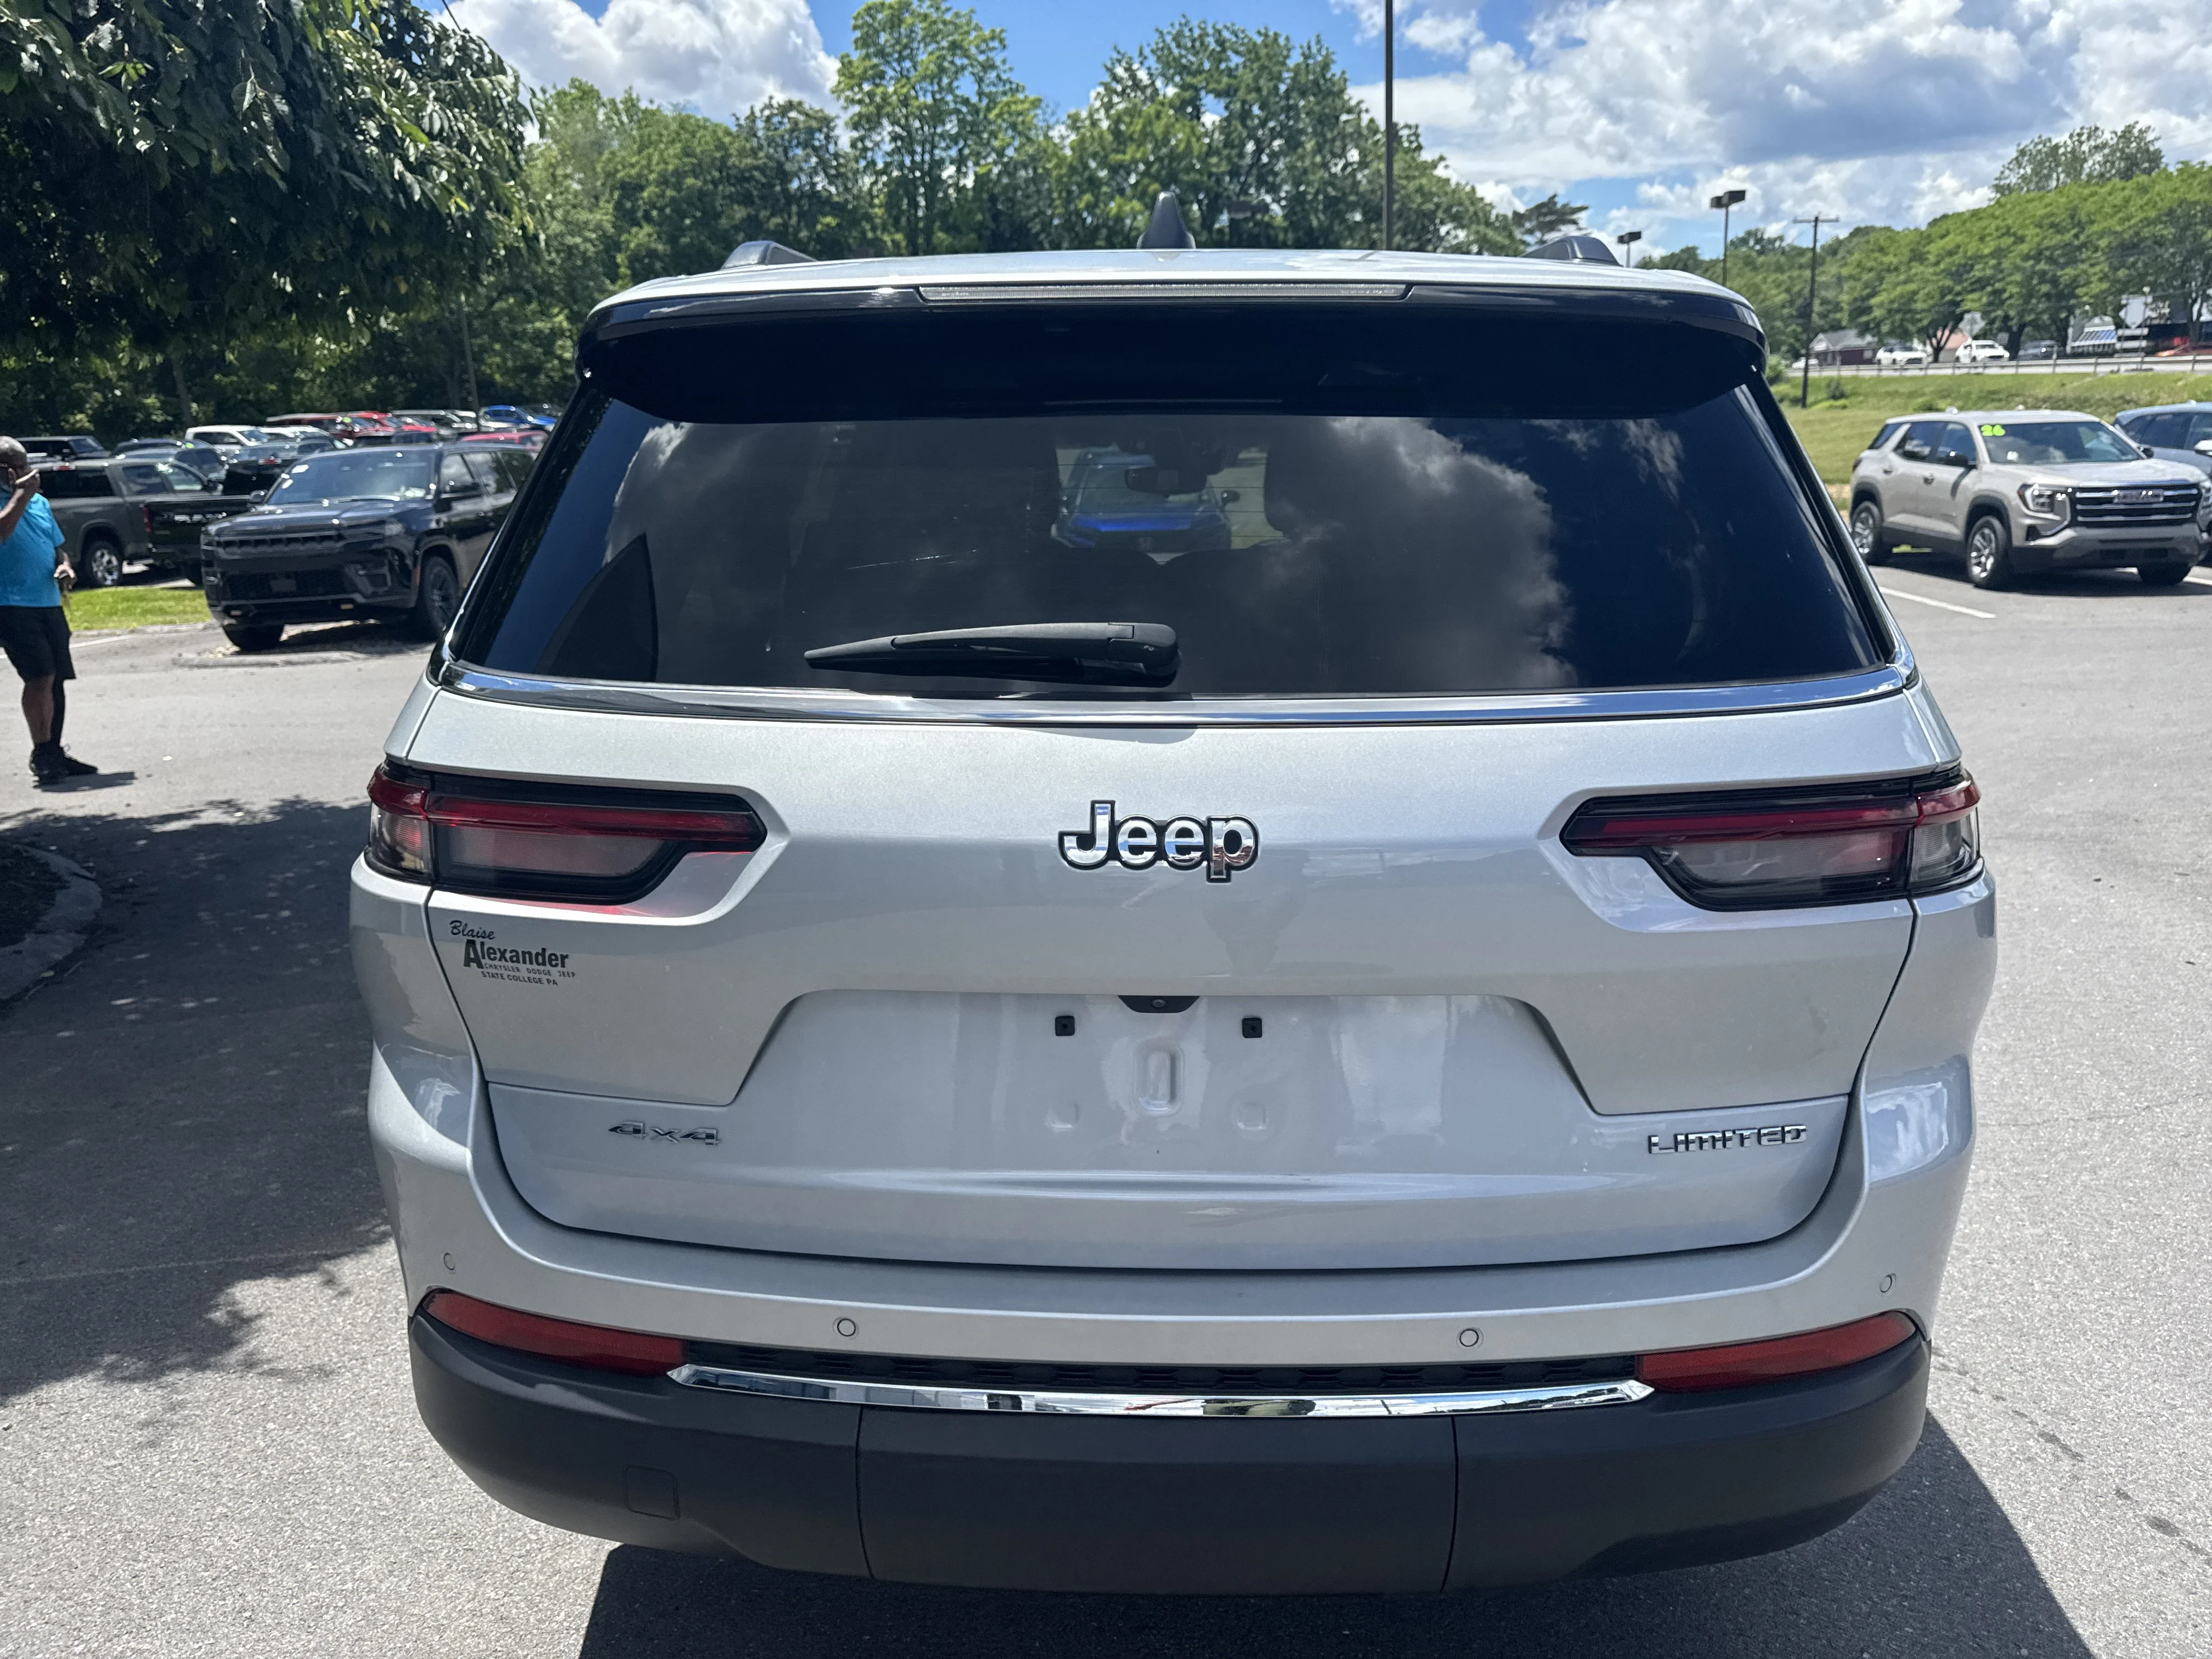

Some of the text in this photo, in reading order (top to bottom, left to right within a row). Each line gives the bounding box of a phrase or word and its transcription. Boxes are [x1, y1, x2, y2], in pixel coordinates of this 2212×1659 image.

[1058, 800, 1260, 883] Jeep
[449, 919, 495, 940] Blaise
[464, 939, 569, 969] Alexander
[481, 971, 505, 980] STATE
[507, 974, 544, 985] COLLEGE
[483, 963, 521, 973] CHRYSLER
[527, 967, 552, 976] DODGE
